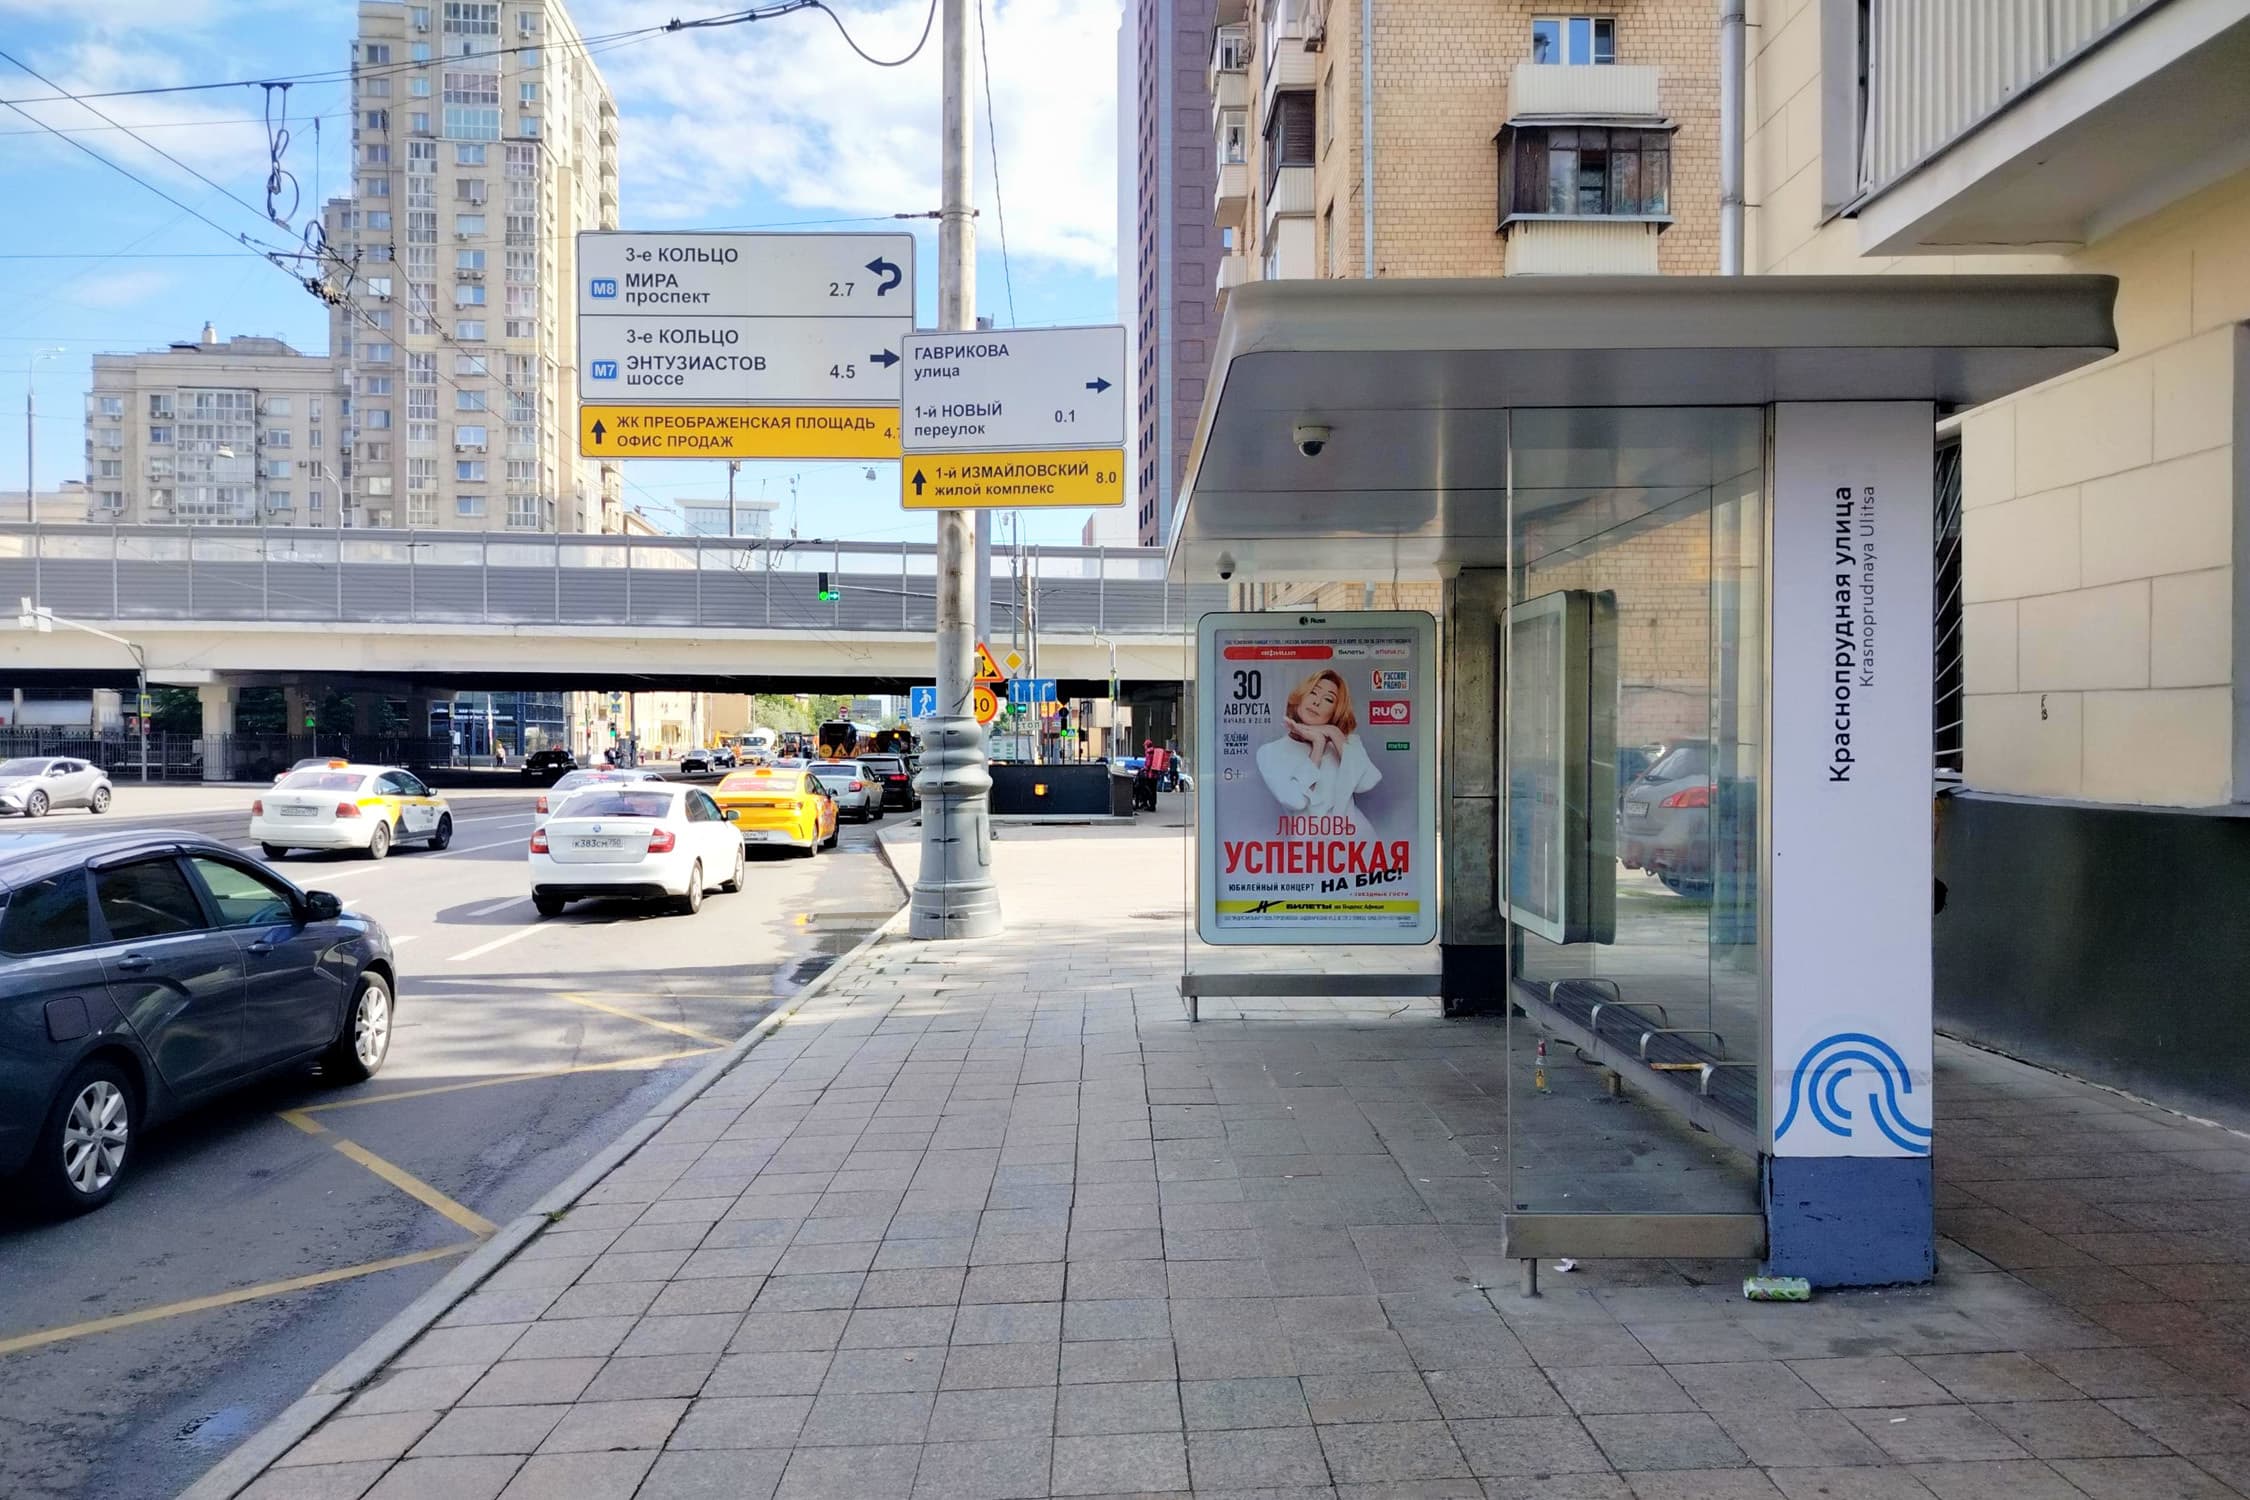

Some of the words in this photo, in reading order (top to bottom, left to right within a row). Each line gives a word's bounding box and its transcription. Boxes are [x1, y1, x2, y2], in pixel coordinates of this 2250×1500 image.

[625, 248, 652, 262] 3-е
[658, 247, 738, 265] КОЛЬЦО
[625, 274, 678, 288] МИРА
[625, 291, 711, 306] проспект
[829, 283, 855, 297] 2.7
[626, 330, 653, 343] 3-е
[659, 329, 739, 346] КОЛЬЦО
[914, 344, 1010, 360] ГАВРИКОВА
[626, 356, 767, 371] ЭНТУЗИАСТОВ
[626, 373, 684, 386] шоссе
[829, 365, 855, 379] 4.5
[914, 366, 960, 381] улица
[914, 405, 937, 418] 1-й
[942, 400, 1003, 417] НОВЫЙ
[1054, 410, 1076, 423] 0.1
[617, 416, 641, 429] ЖК
[643, 417, 791, 430] ПРЕОБРАЖЕНСКАЯ
[796, 418, 876, 431] ПЛОЩАДЬ
[914, 423, 985, 438] переулок
[617, 435, 662, 448] ОФИС
[667, 435, 733, 448] ПРОДАЖ
[935, 466, 957, 479] 1-й
[961, 460, 1089, 478] ИЗМАЙЛОВСКИЙ
[1095, 471, 1117, 484] 8.0
[935, 483, 981, 496] жилой
[986, 483, 1055, 496] комплекс
[1859, 486, 1875, 537] Ulitsa
[1835, 486, 1856, 565] улица
[1859, 542, 1877, 687] Krasnoprudnaya
[1233, 670, 1261, 700] 30
[1829, 573, 1855, 782] Краснопрудная
[974, 697, 990, 712] 0
[1224, 703, 1271, 715] АВГУСТА
[1224, 767, 1242, 780] 6+
[1276, 815, 1356, 836] ЛЮБОВЬ
[1224, 840, 1410, 875] УСПЕНСКАЯ
[1228, 882, 1279, 892] ЮБИЛЕЙНЫЙ
[1281, 883, 1315, 893] КОНЦЕРТ
[1321, 877, 1349, 893] НА
[1355, 867, 1403, 887] БИС!
